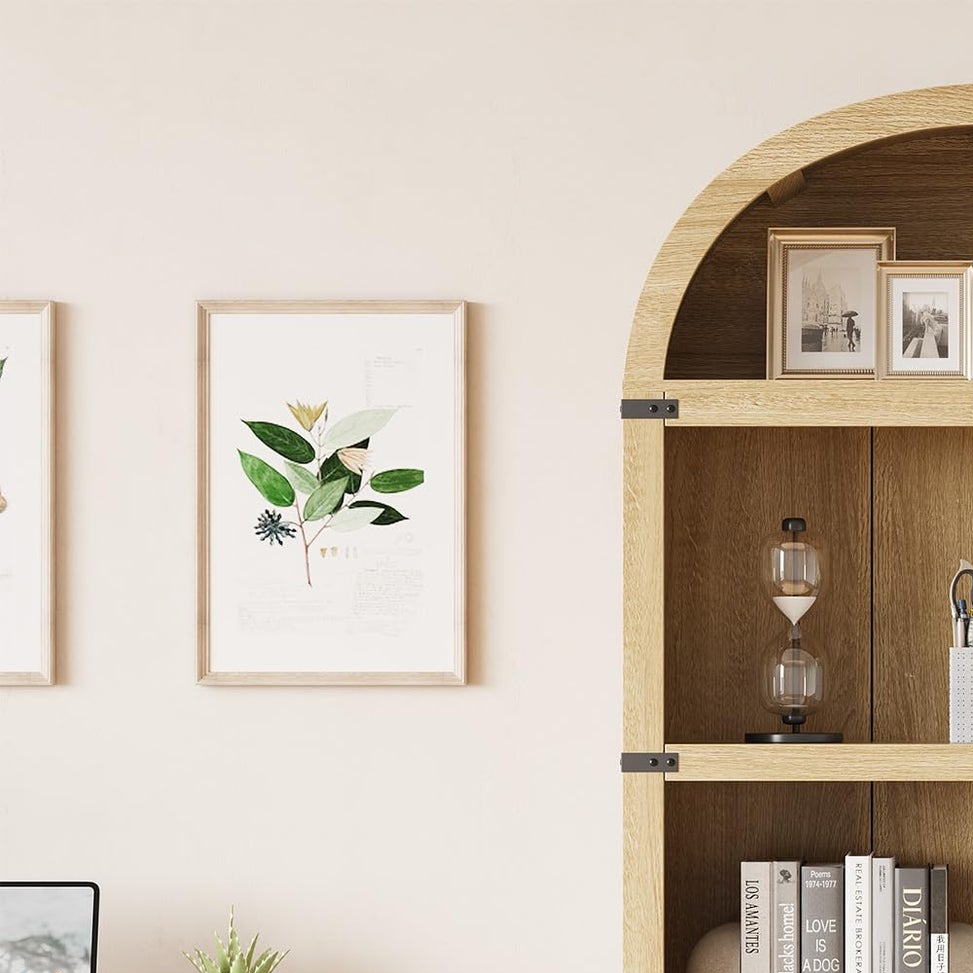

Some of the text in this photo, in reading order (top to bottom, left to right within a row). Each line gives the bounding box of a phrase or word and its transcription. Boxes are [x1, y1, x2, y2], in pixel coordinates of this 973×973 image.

[805, 880, 837, 888] 1974-1977
[745, 880, 759, 954] LOS AMANTES
[779, 903, 794, 942] home!
[806, 919, 837, 933] LOVE
[902, 887, 926, 967] DIÁRIO
[816, 939, 826, 952] IS
[803, 958, 840, 972] A DOG
